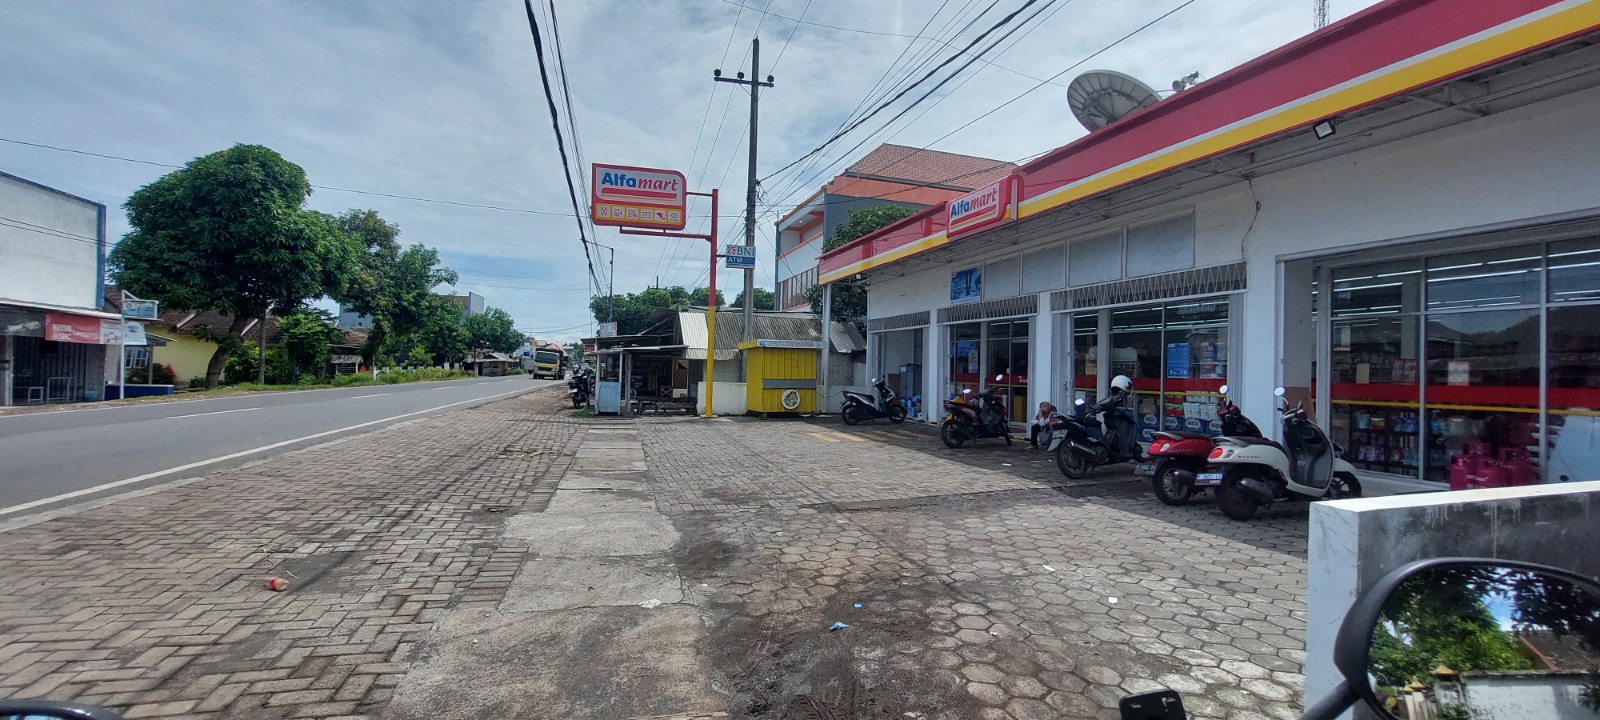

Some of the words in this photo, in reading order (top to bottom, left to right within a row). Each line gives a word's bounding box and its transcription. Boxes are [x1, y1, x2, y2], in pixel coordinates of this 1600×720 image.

[601, 172, 679, 192] Alfamart
[950, 187, 998, 219] Alfamart
[737, 246, 755, 257] BNI
[727, 256, 743, 264] ATM
